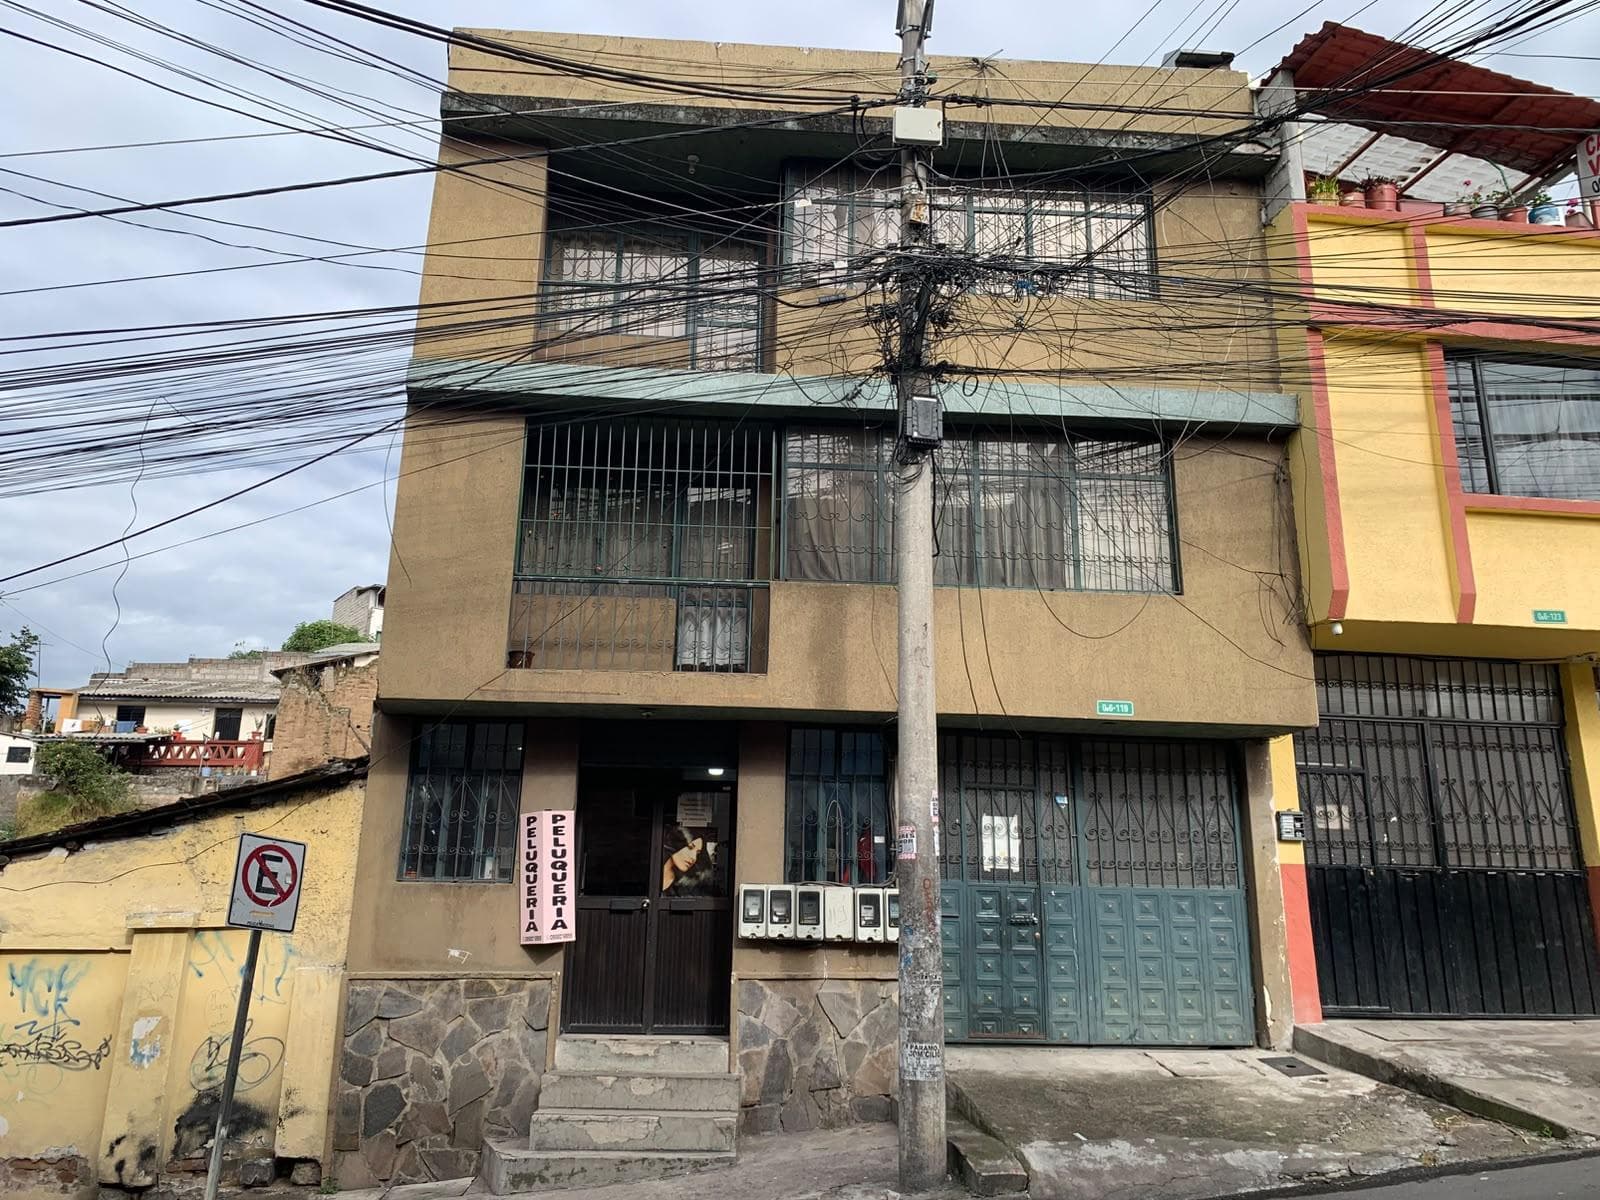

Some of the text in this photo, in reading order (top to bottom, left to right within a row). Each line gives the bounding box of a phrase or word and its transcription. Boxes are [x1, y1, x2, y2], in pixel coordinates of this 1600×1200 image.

[255, 854, 284, 895] E
[525, 815, 539, 933] PELUQUERIA
[550, 814, 568, 931] PELUQUERIA
